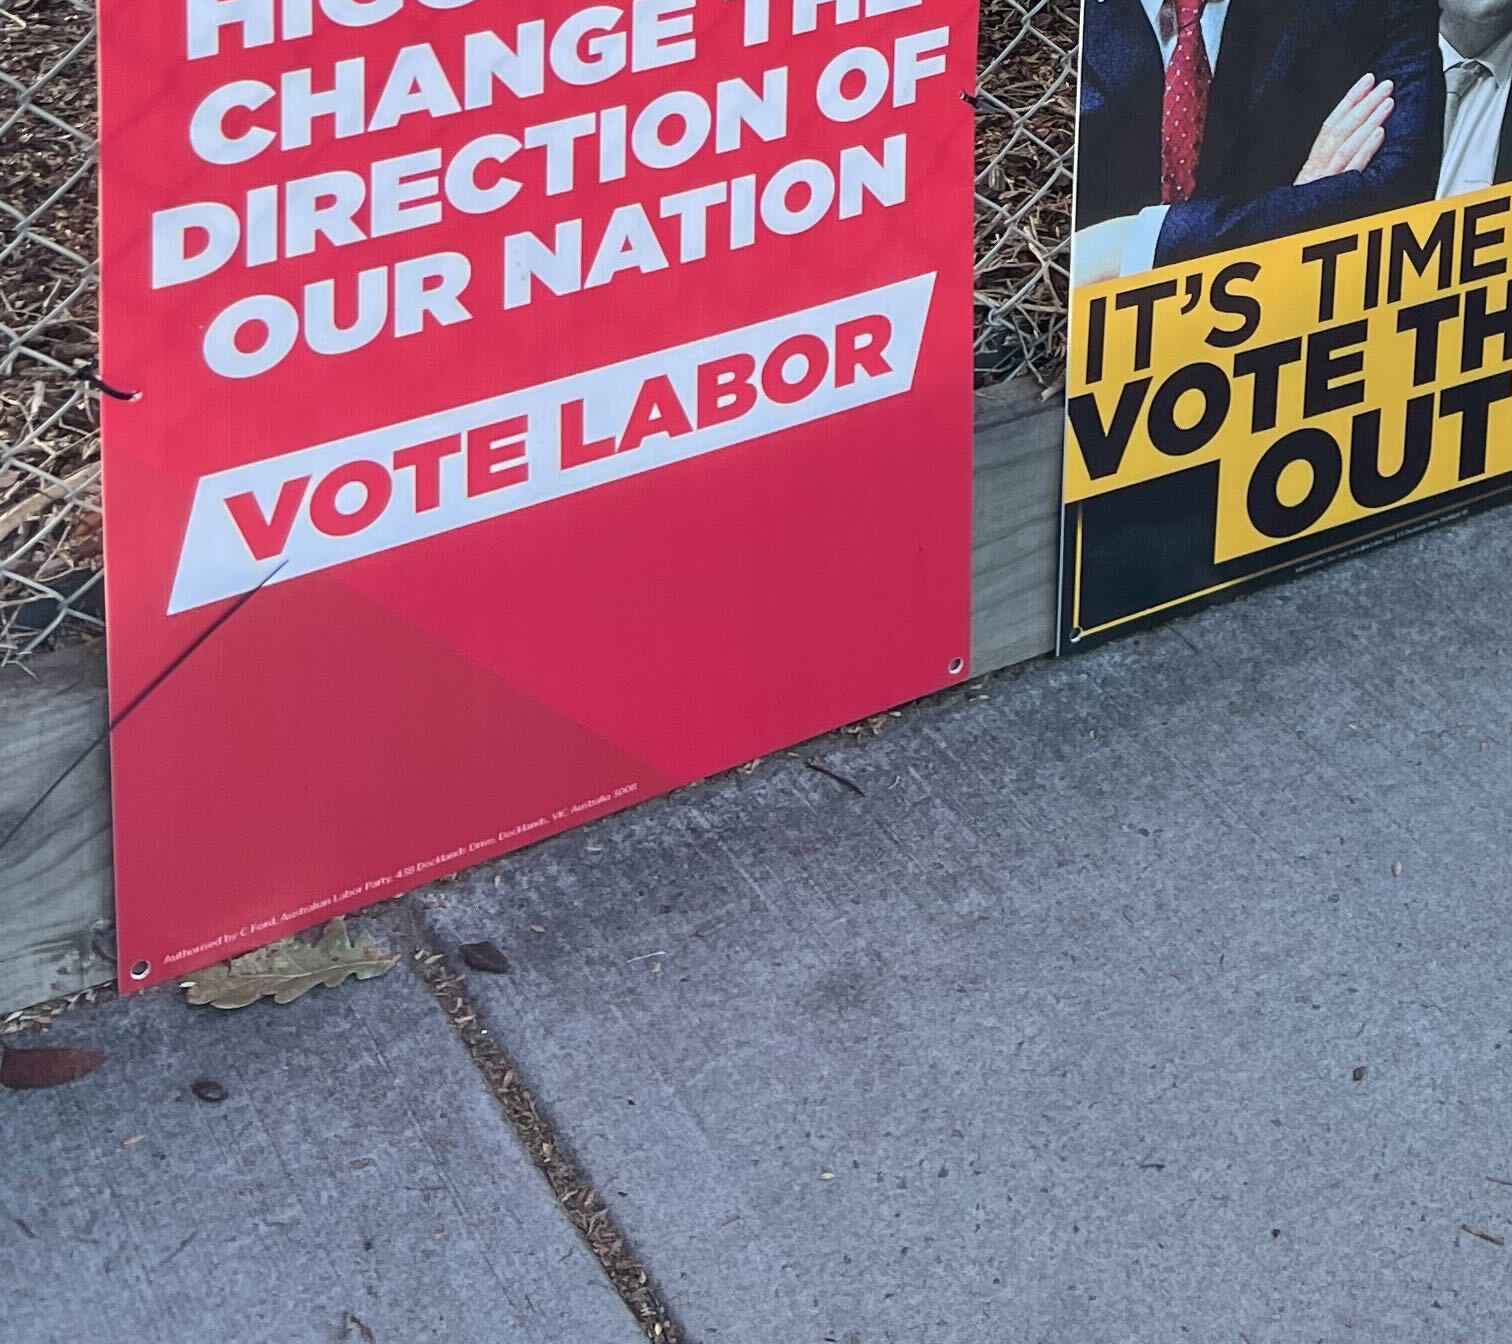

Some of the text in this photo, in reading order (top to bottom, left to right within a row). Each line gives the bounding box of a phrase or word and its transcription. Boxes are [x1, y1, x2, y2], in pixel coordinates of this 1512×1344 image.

[149, 26, 950, 291] DIRECTION OF
[201, 134, 908, 381] OUR NATION
[1085, 261, 1263, 386] IT'S
[1302, 195, 1511, 323] TIME
[224, 314, 894, 564] VOTE LABOR
[1066, 318, 1368, 481] VOTE
[1246, 370, 1512, 540] OUT
[163, 936, 223, 965] Authorised
[223, 932, 238, 944] by
[239, 927, 250, 938] C
[280, 898, 332, 922] Australian
[332, 886, 362, 904] Labor
[570, 793, 612, 814] Australia
